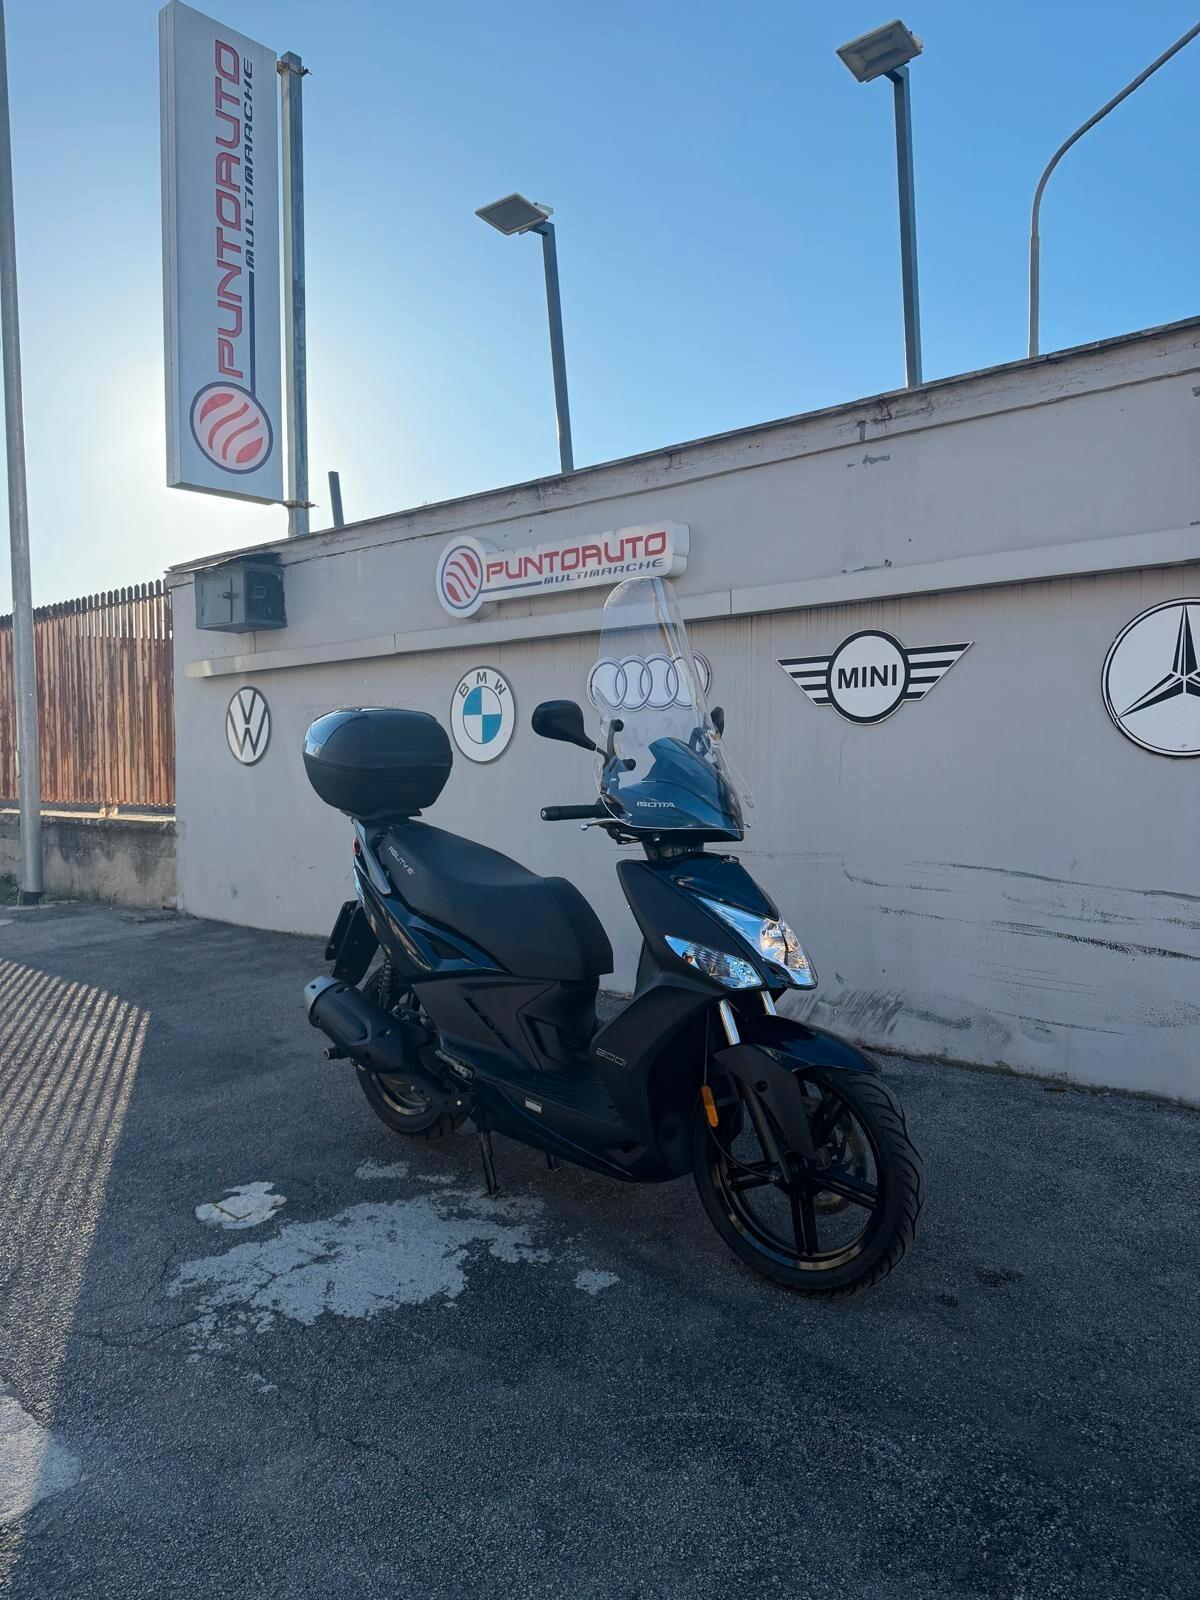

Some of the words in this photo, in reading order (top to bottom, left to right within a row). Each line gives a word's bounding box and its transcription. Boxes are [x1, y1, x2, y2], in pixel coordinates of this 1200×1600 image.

[243, 57, 254, 270] MULTIMARCHE
[215, 38, 243, 379] PUNTOAUTO
[486, 531, 666, 584] PUNTOAUTO
[543, 557, 664, 585] MULTIMARCHE
[458, 671, 507, 698] BMW
[837, 664, 898, 690] MINI
